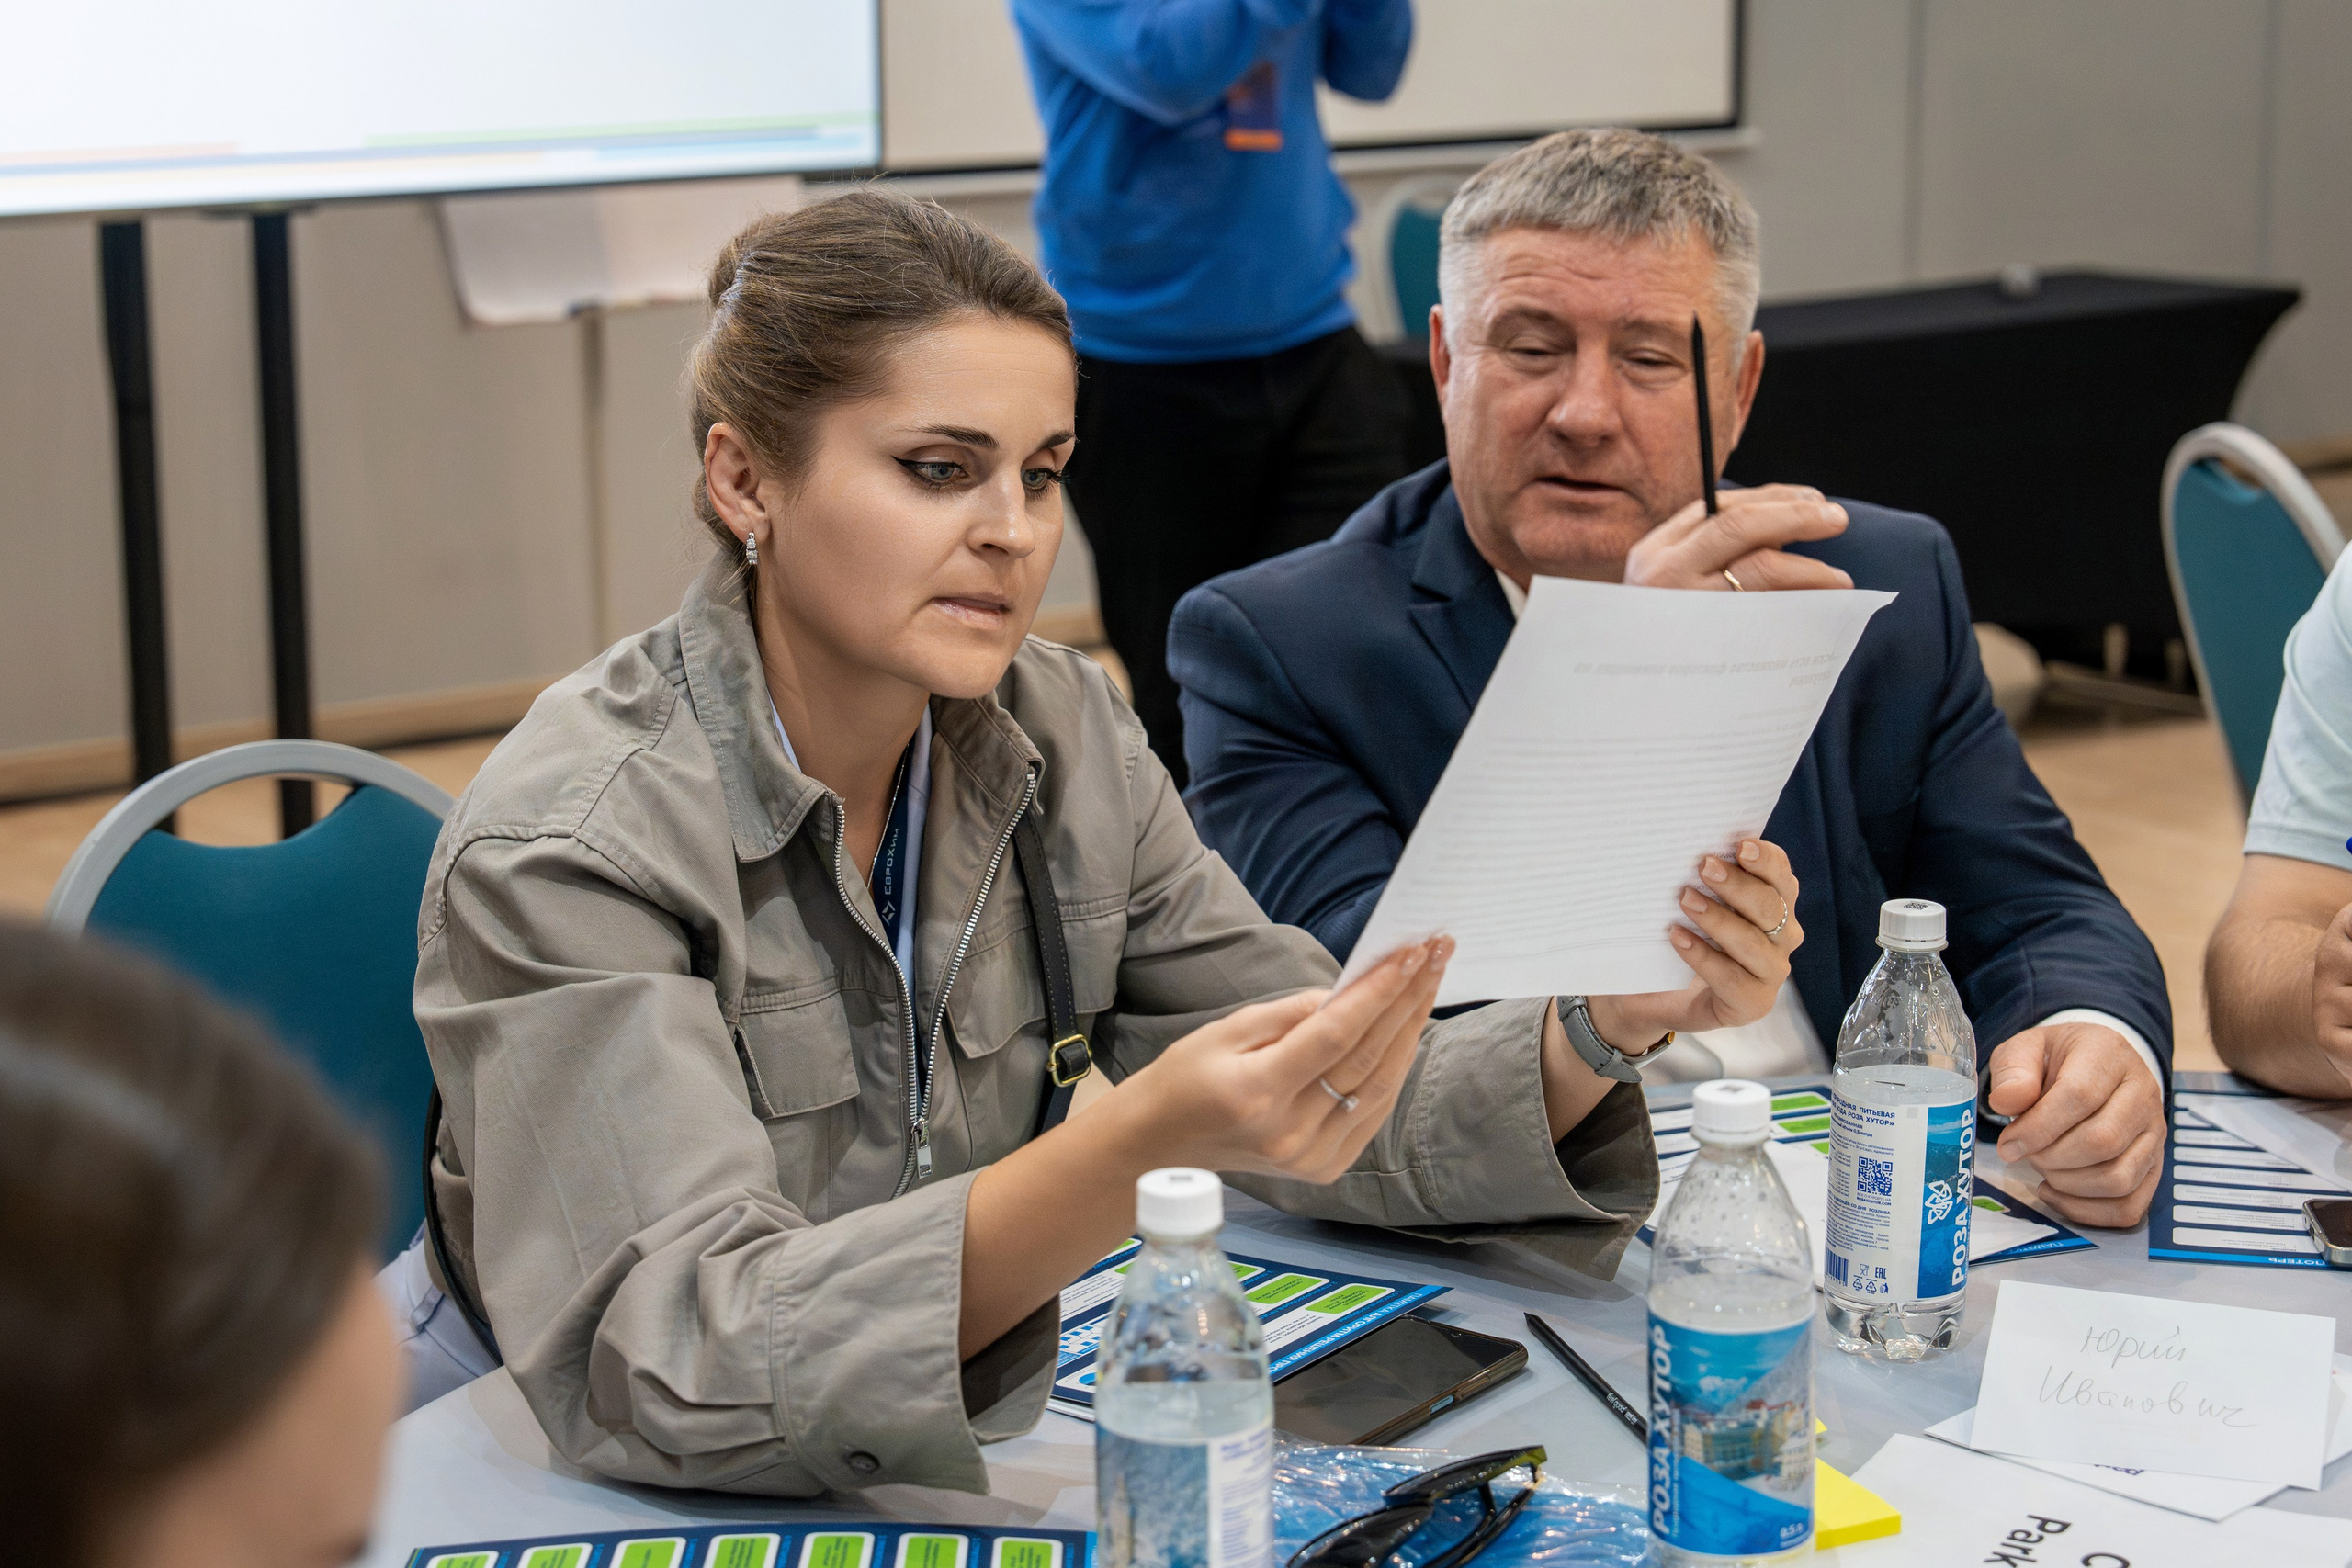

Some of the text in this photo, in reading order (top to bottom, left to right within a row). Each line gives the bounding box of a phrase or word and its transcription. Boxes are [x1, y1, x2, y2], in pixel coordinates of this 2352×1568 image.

[885, 828, 899, 896] ЕВРОХИМ
[1848, 1111, 1864, 1122] РОЗА
[1866, 1116, 1894, 1127] ХУТОР»
[1859, 1108, 1895, 1119] ПИТЬЕВАЯ
[1957, 1108, 1974, 1204] ХУТОР
[1951, 1209, 1968, 1286] РОЗА
[2268, 1257, 2325, 1267] ПОТЕРЬ
[1333, 1307, 1384, 1339] АЛГОРИТМ
[1383, 1292, 1423, 1313] ПАМЯТКА
[2080, 1325, 2187, 1369] Юрий
[2039, 1365, 2256, 1427] Иванович
[1652, 1324, 1673, 1535] РОЗА ХУТОР
